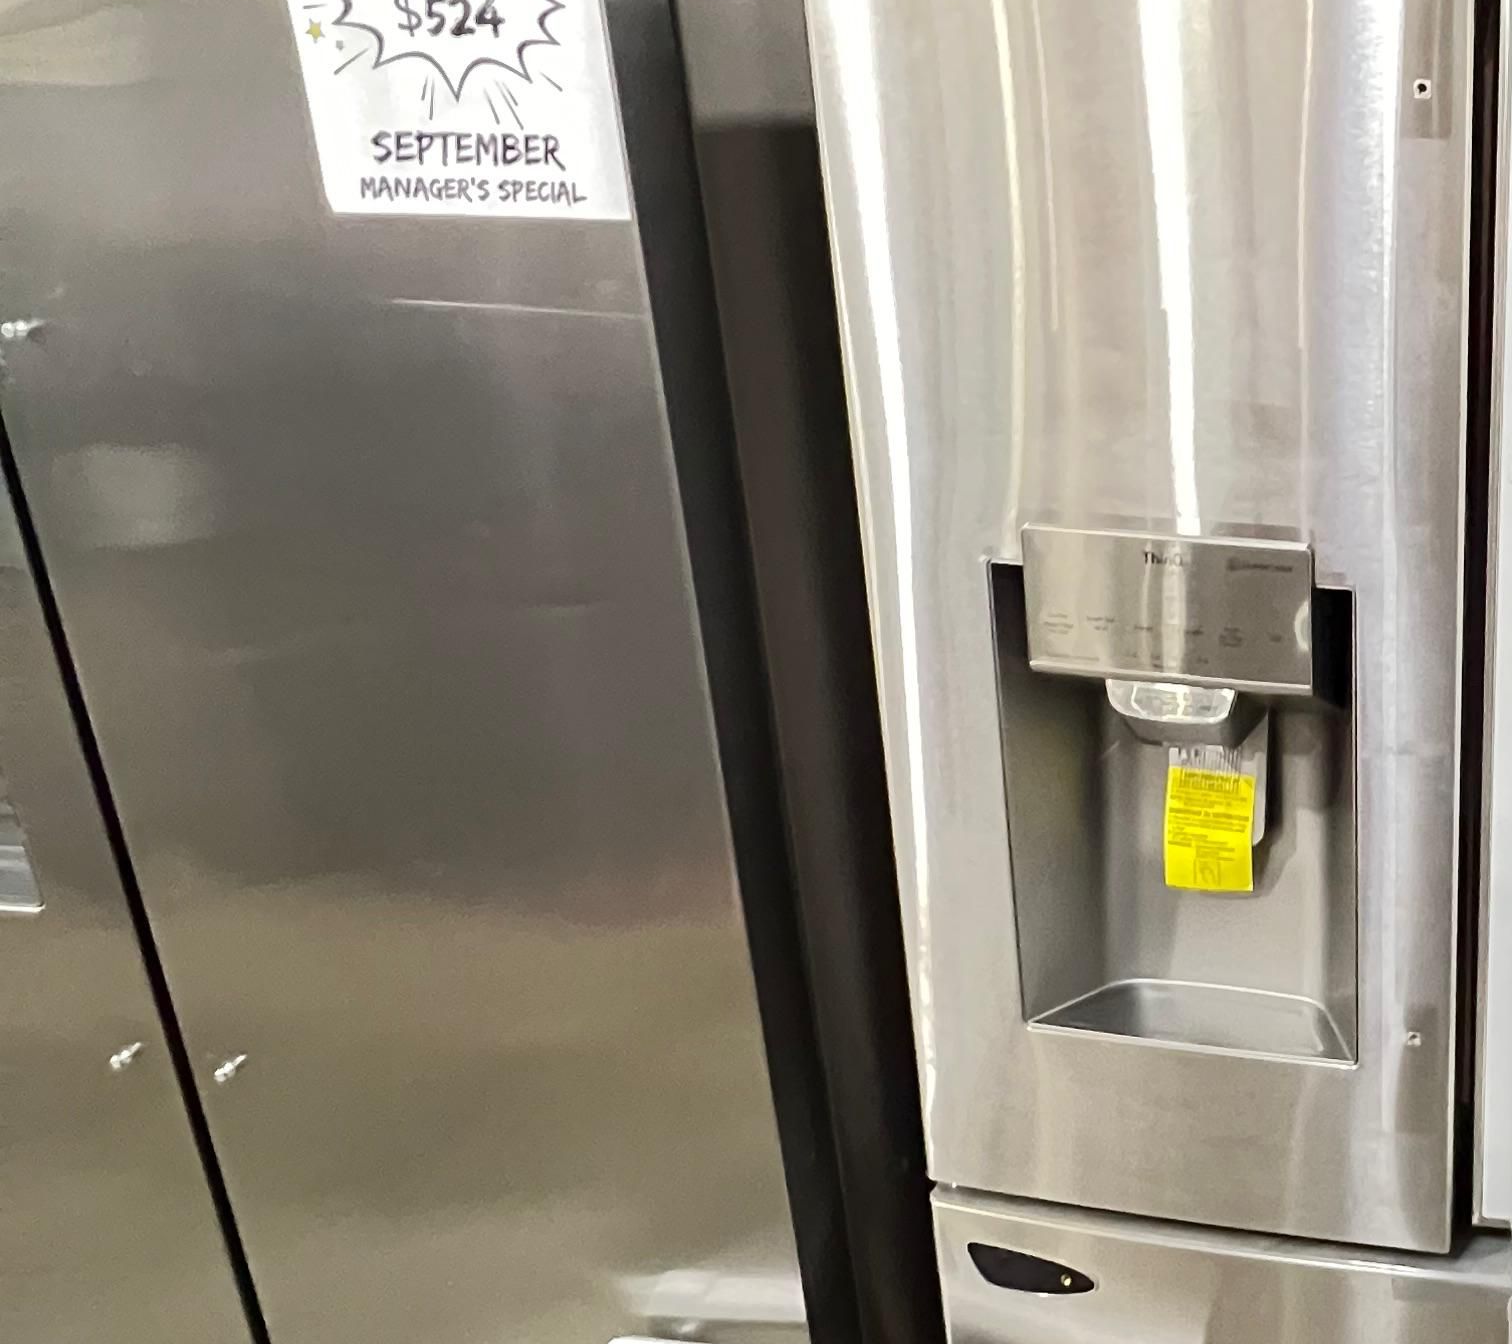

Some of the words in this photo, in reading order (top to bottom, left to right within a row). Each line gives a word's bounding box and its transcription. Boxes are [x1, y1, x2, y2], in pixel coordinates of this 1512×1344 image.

[370, 130, 566, 171] SEPTEMBER
[360, 176, 490, 202] MANAGER'S
[498, 180, 587, 206] SPECIAL
